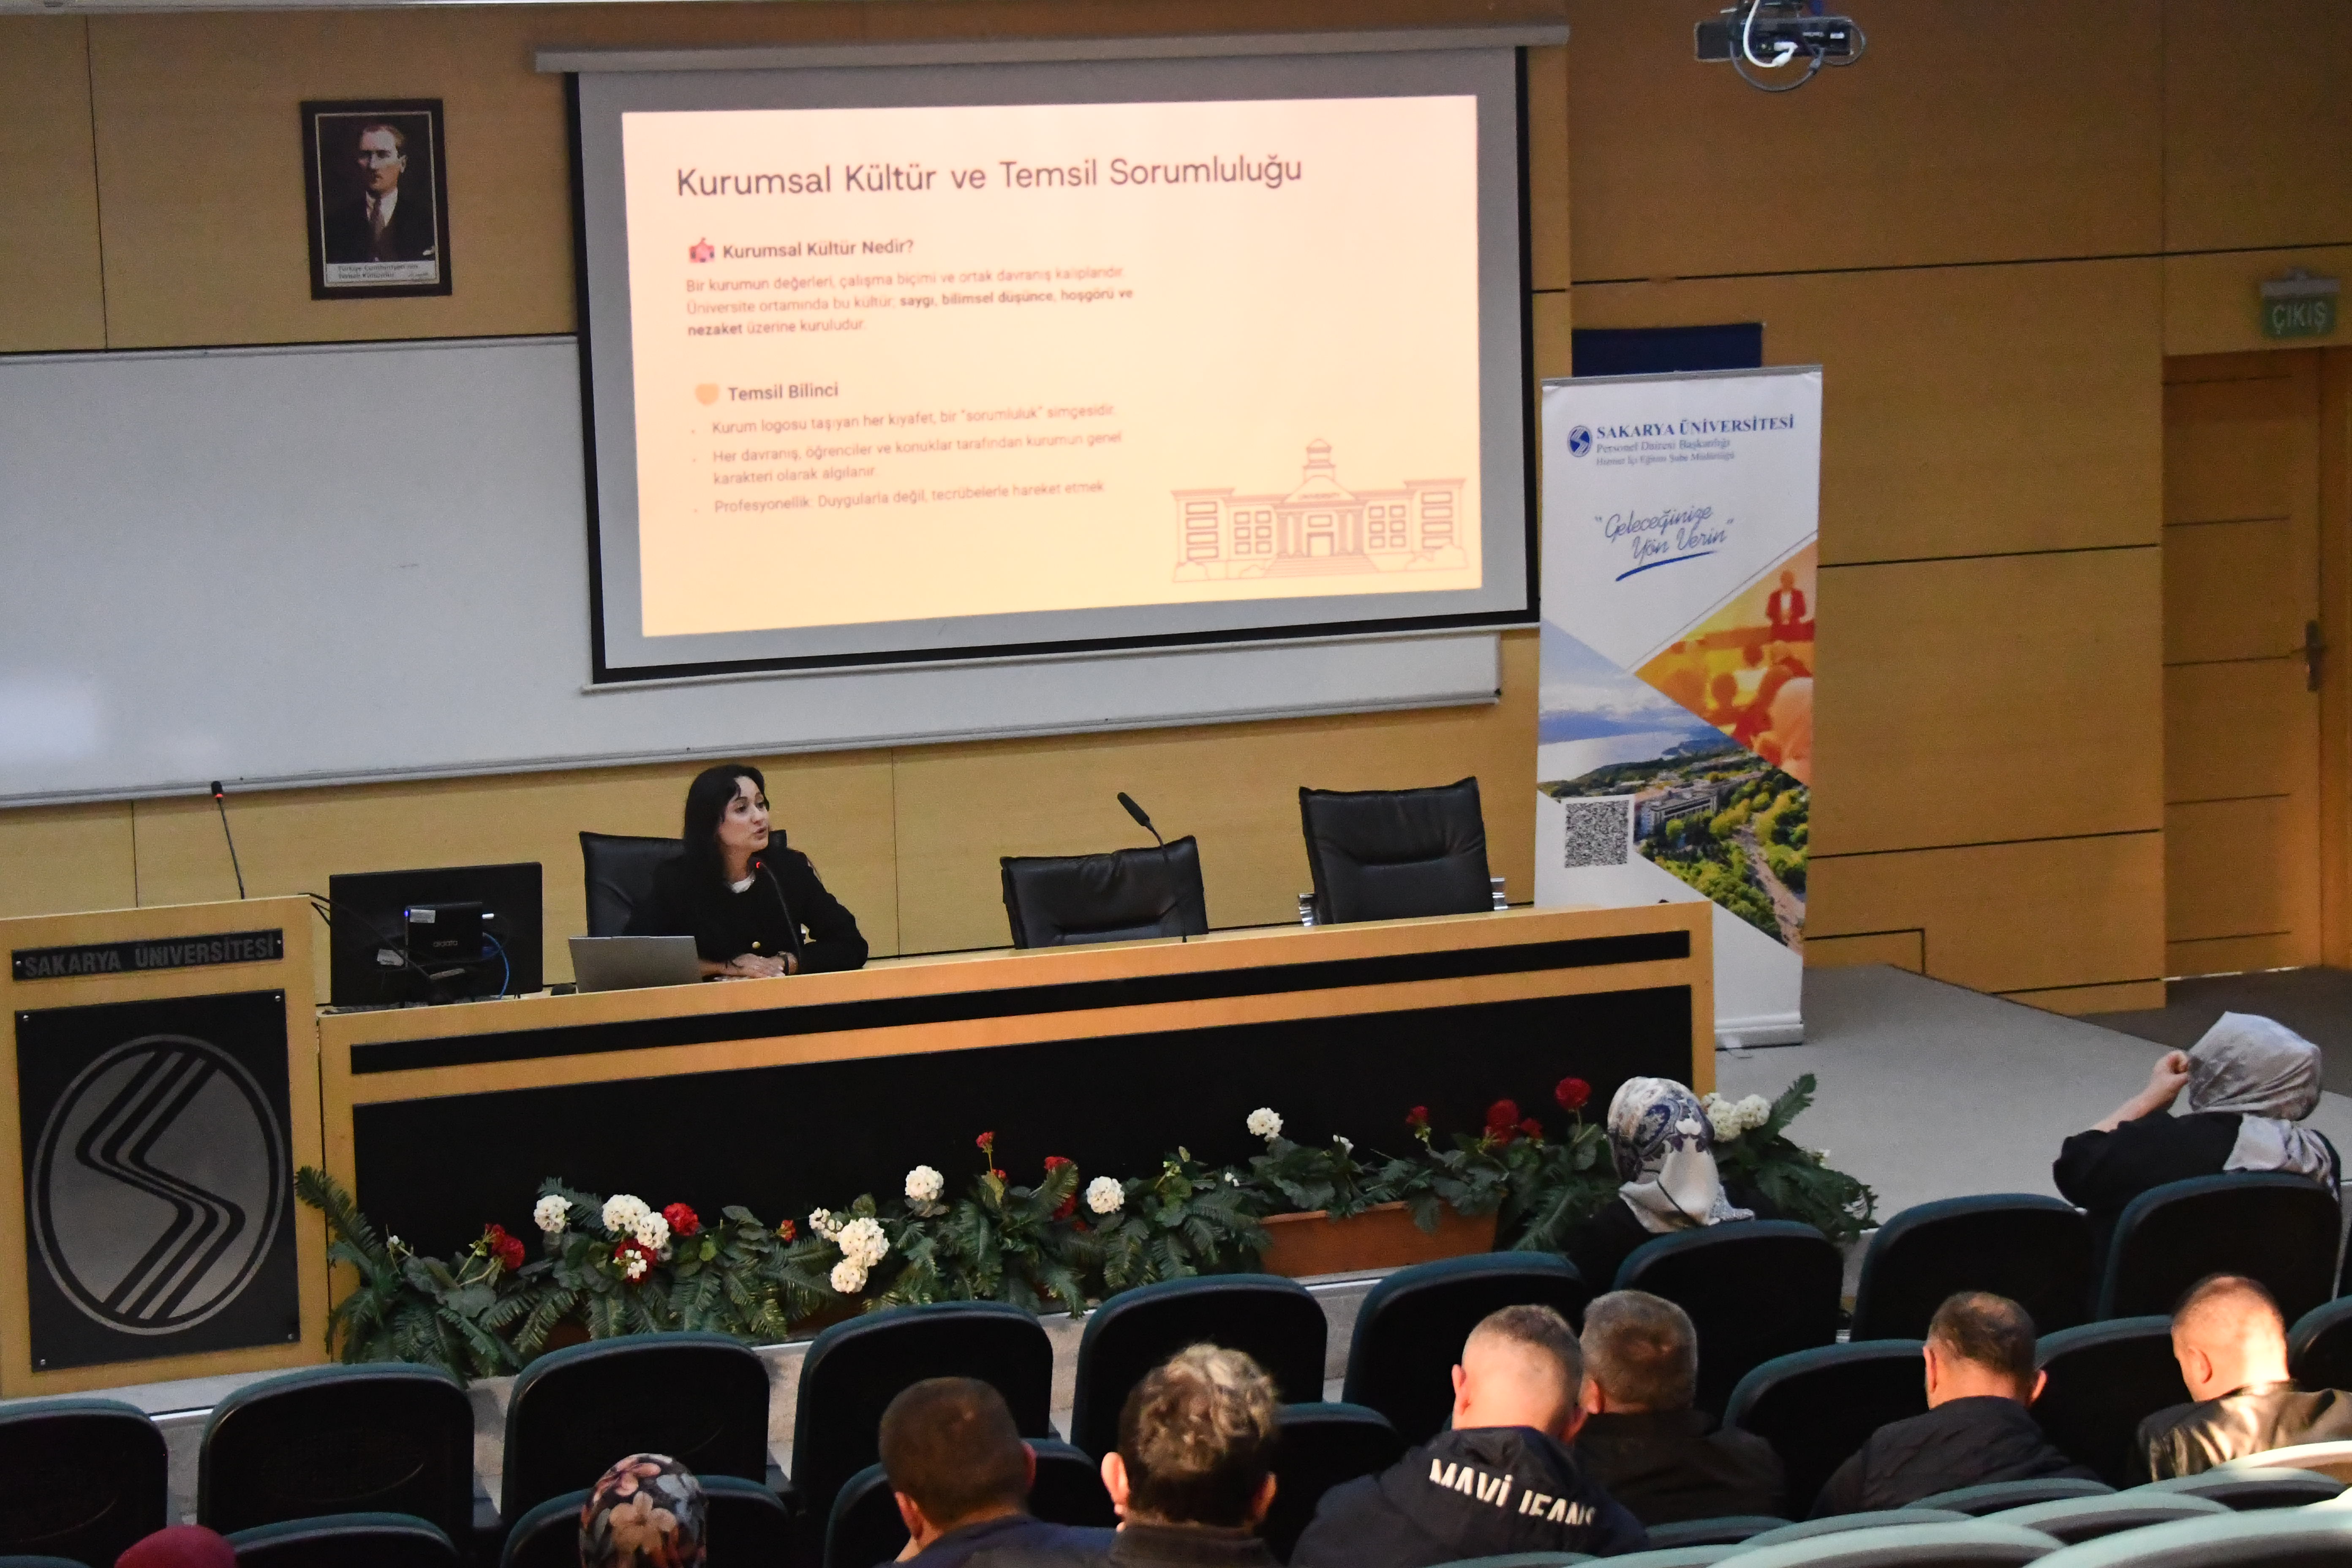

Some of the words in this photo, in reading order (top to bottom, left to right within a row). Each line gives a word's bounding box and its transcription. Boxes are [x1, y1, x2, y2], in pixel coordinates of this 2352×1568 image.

[678, 165, 830, 196] Kurumsal
[846, 163, 936, 192] Kültür
[951, 169, 985, 189] ve
[1000, 159, 1097, 188] Temsil
[1110, 154, 1302, 189] Sorumluluğu
[723, 242, 802, 259] Kurumsal
[807, 240, 856, 256] Kültür
[863, 239, 914, 254] Nedir?
[686, 279, 705, 292] Bir
[709, 278, 769, 291] kurumun
[840, 274, 893, 288] çalışma
[897, 271, 936, 286] biçimi
[940, 274, 955, 283] ve
[959, 270, 992, 283] ortak
[997, 269, 1052, 282] davranış
[687, 300, 756, 314] Üniversite
[760, 298, 828, 312] ortamında
[833, 297, 850, 309] bu
[942, 291, 994, 305] bilimsel
[1061, 288, 1114, 303] hoşgörü
[1119, 290, 1134, 299] ve
[688, 322, 743, 336] nezaket
[747, 321, 796, 335] üzerine
[728, 384, 783, 401] Temsil
[789, 382, 839, 399] Bilinci
[712, 420, 757, 434] Kurum
[761, 419, 808, 434] logosu
[811, 416, 859, 432] taşıyan
[863, 414, 884, 427] her
[941, 410, 956, 422] bir
[1597, 422, 1675, 439] SAKARYA
[1680, 414, 1795, 436] ÜNİVERSİTESİ
[713, 450, 737, 463] Her
[806, 442, 872, 460] öğrenciler
[877, 444, 891, 455] ve
[896, 439, 952, 454] konuklar
[956, 436, 1023, 451] tarafından
[1027, 433, 1083, 447] kurumun
[1087, 430, 1123, 448] genel
[714, 470, 772, 486] karakteri
[777, 467, 818, 482] olarak
[818, 491, 888, 509] Duygularla
[932, 483, 1009, 501] tecrübelerle
[1013, 481, 1062, 497] hareket
[1064, 479, 1105, 494] etmek
[1632, 536, 1669, 565] Yön
[24, 950, 122, 978] SAKARYA
